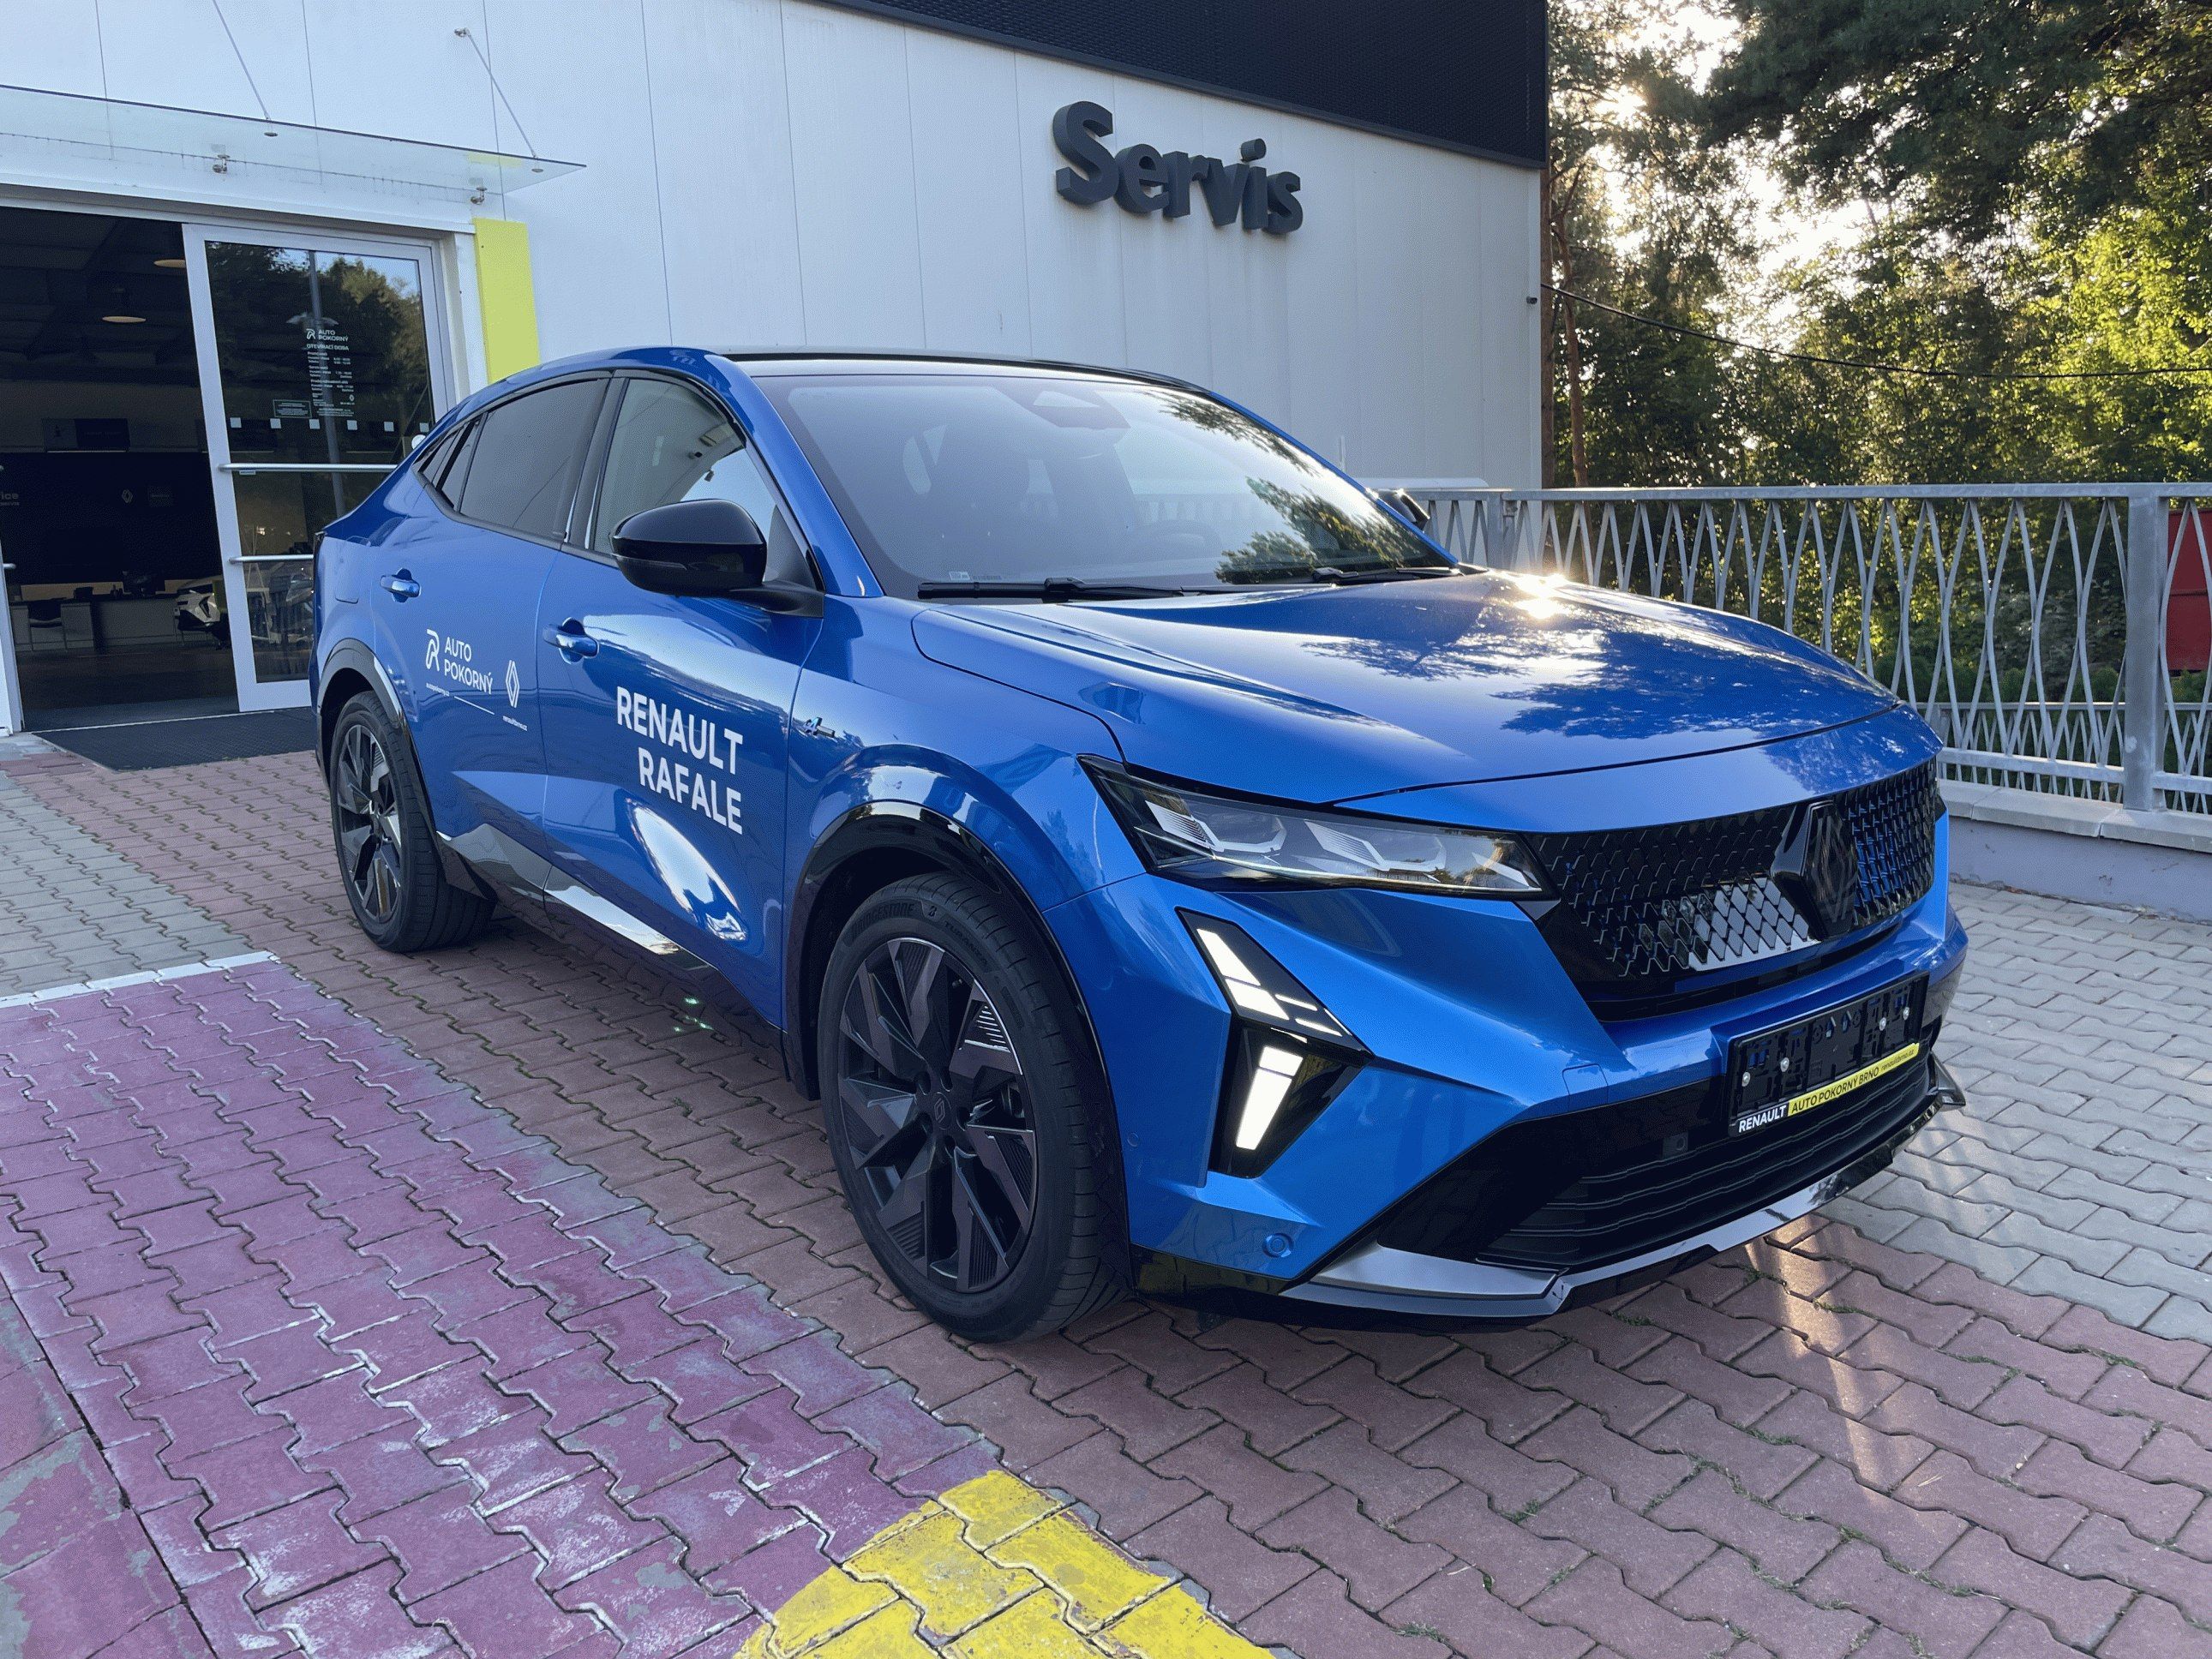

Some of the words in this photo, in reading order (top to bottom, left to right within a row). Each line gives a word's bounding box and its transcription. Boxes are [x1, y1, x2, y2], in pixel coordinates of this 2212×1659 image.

[1052, 100, 1304, 235] Servis
[444, 637, 472, 662] AUTO
[444, 659, 494, 695] POKORNÝ
[616, 686, 743, 776] RENAULT
[638, 747, 743, 835] RAFALE
[1738, 1105, 1787, 1133] RENAULT
[1791, 1095, 1818, 1114] AUTO
[1858, 1067, 1879, 1085] BRNO
